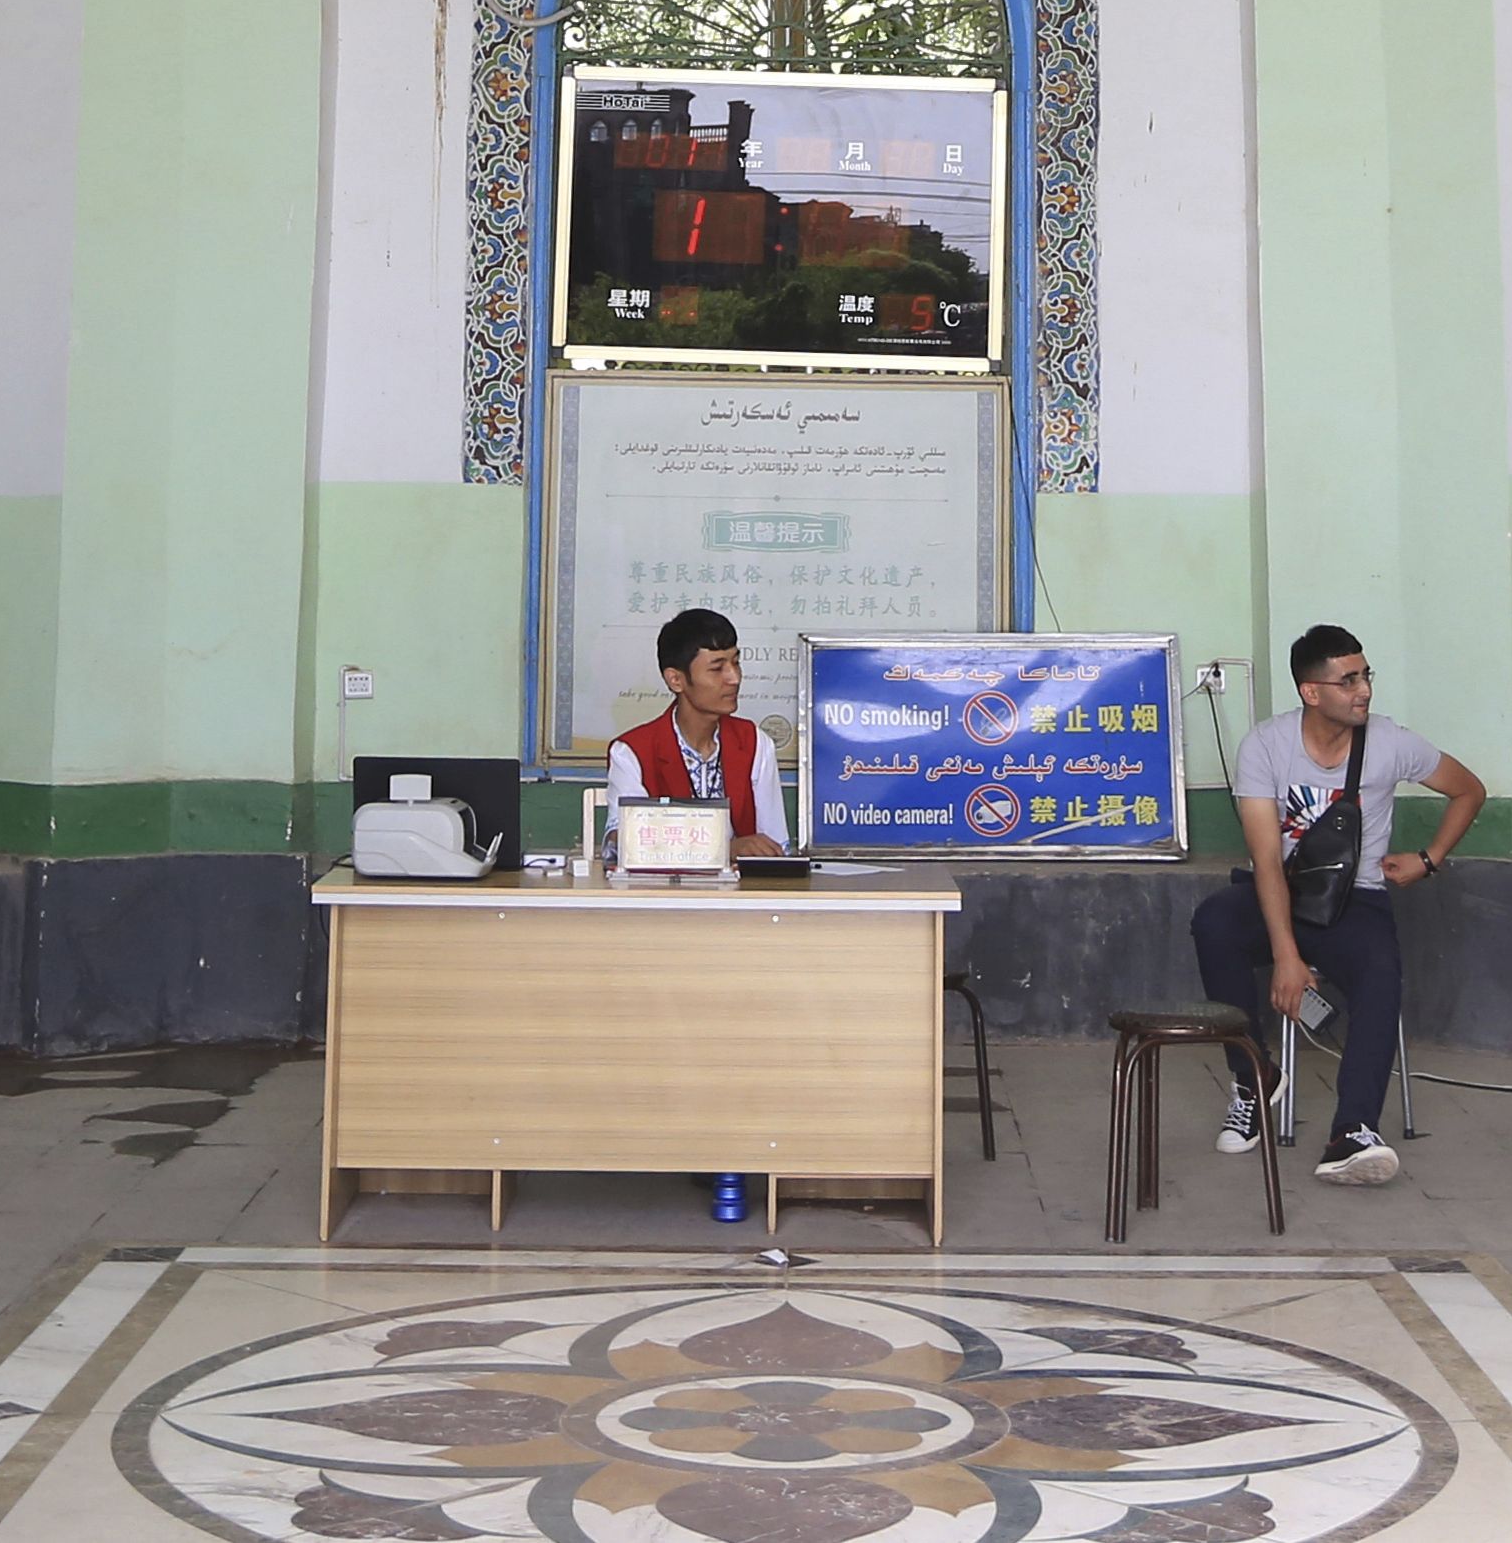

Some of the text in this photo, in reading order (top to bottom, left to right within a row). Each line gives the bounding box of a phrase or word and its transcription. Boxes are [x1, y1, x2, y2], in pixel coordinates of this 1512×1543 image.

[741, 140, 763, 158] 年
[845, 141, 865, 160] 月
[946, 145, 963, 162] 日
[739, 158, 764, 169] Year
[839, 160, 872, 172] Month
[943, 163, 964, 176] Day
[607, 289, 650, 308] 星期
[839, 295, 875, 313] 温度
[614, 308, 645, 320] Week
[839, 314, 874, 326] Temp
[728, 521, 825, 544] 温馨提示
[883, 664, 1100, 688] تاماكا چەكمەڭ
[824, 703, 950, 732] NO smoking!
[1030, 704, 1159, 734] 禁止吸烟
[823, 801, 954, 826] NO video camera!
[1029, 794, 1161, 827] 禁止摄像
[638, 825, 710, 847] 售票处
